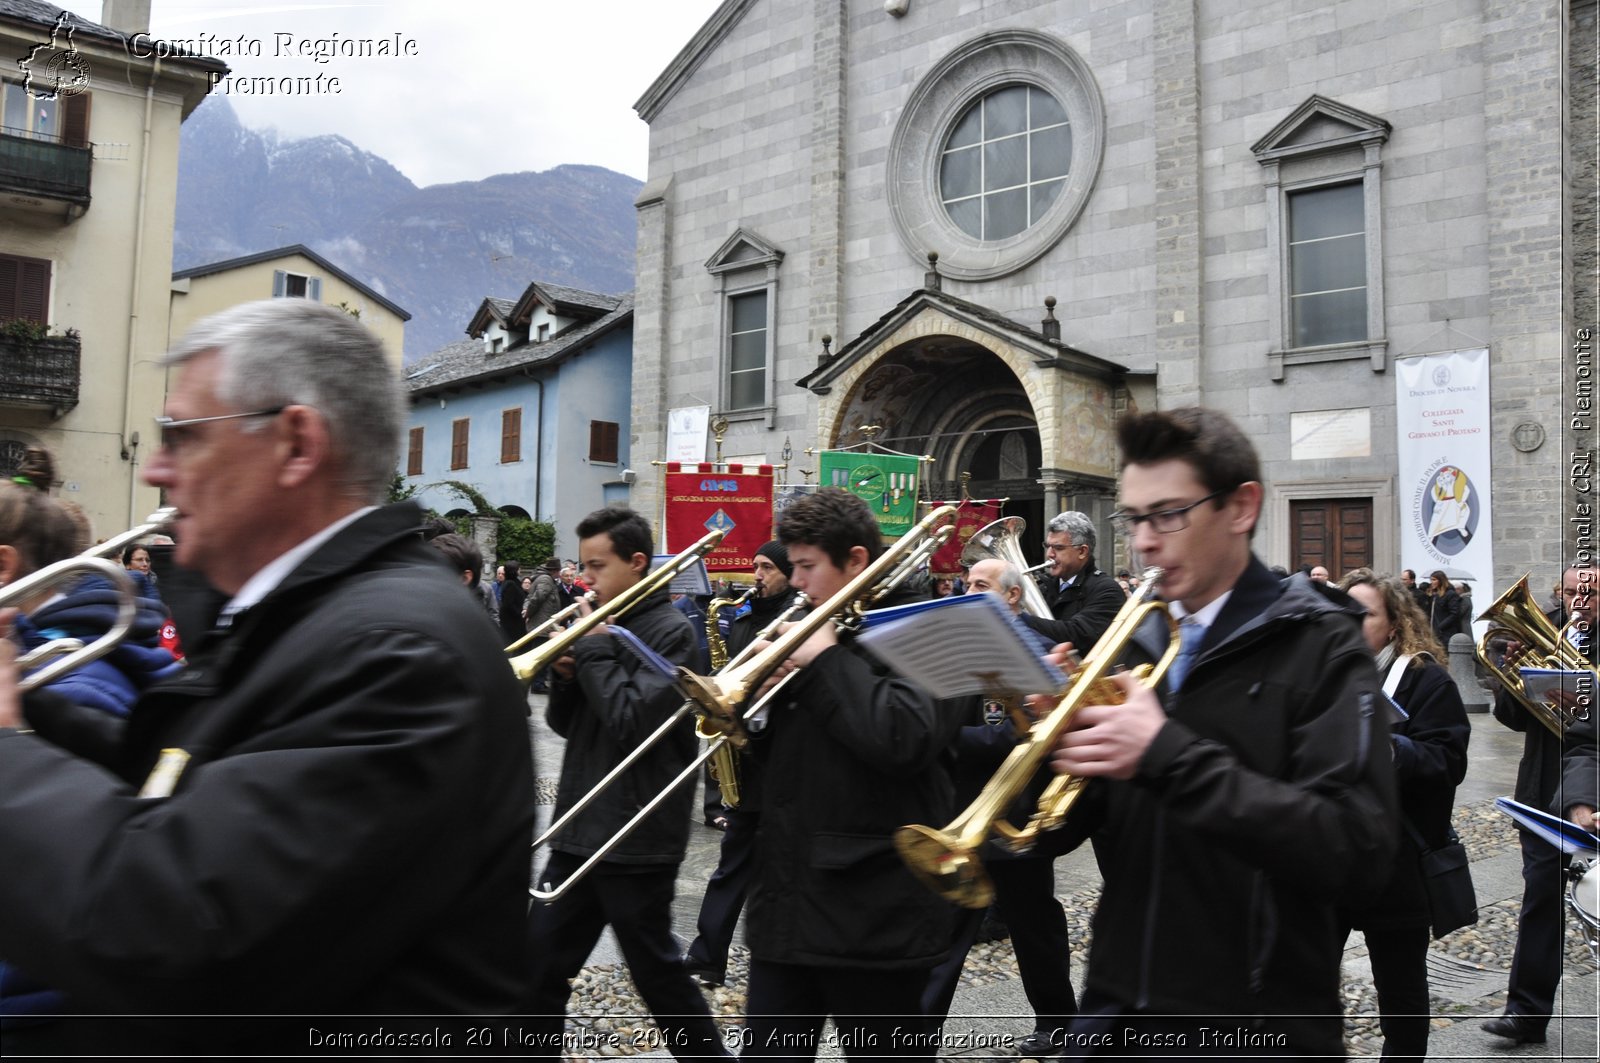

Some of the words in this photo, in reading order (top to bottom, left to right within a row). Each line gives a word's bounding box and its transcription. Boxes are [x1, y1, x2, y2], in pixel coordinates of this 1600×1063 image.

[1422, 408, 1464, 418] COLLEGIATA
[1432, 419, 1454, 427] SANTI
[1408, 431, 1440, 439] GERVASO
[1447, 427, 1481, 436] PROTASO
[1412, 487, 1424, 510] COME
[1423, 455, 1449, 479] PADRE
[704, 557, 754, 566] ODOSSOL
